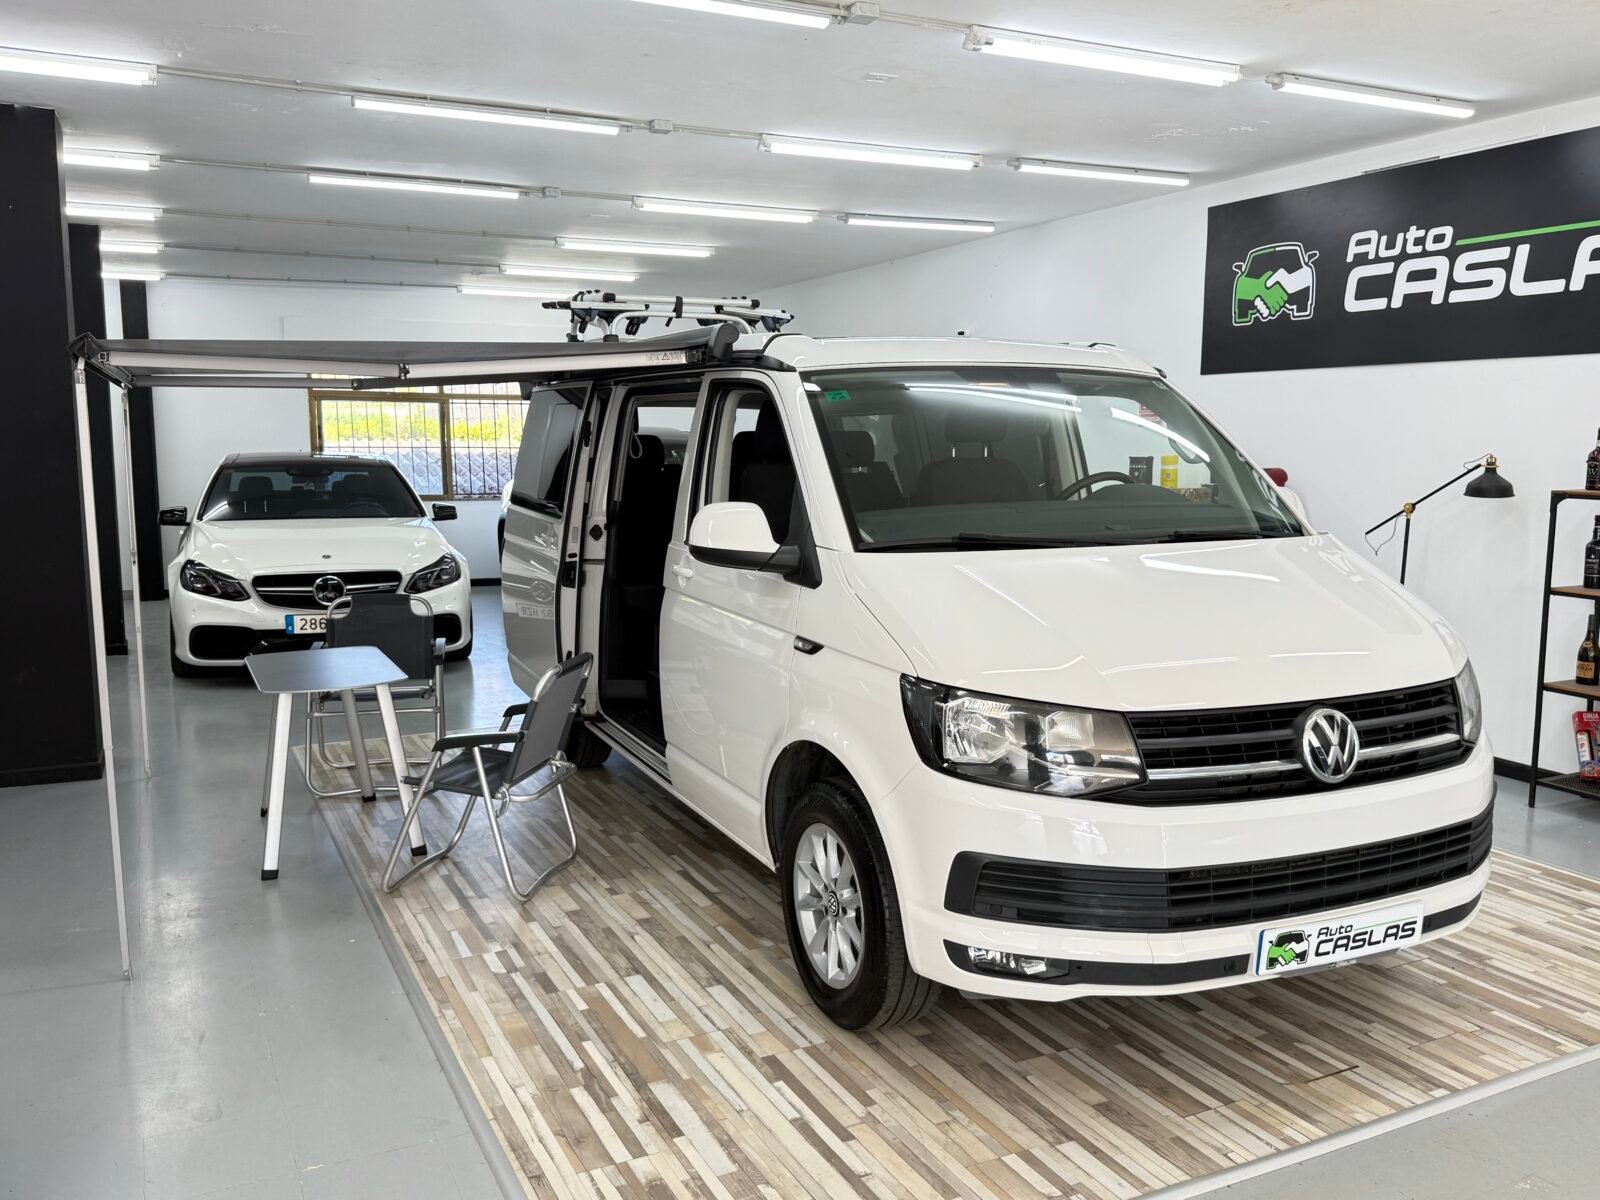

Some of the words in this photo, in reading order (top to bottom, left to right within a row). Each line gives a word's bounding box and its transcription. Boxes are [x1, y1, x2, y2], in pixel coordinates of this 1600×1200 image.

[1346, 225, 1454, 262] Auto
[1315, 921, 1418, 957] CASLAS
[1317, 924, 1353, 938] Auto
